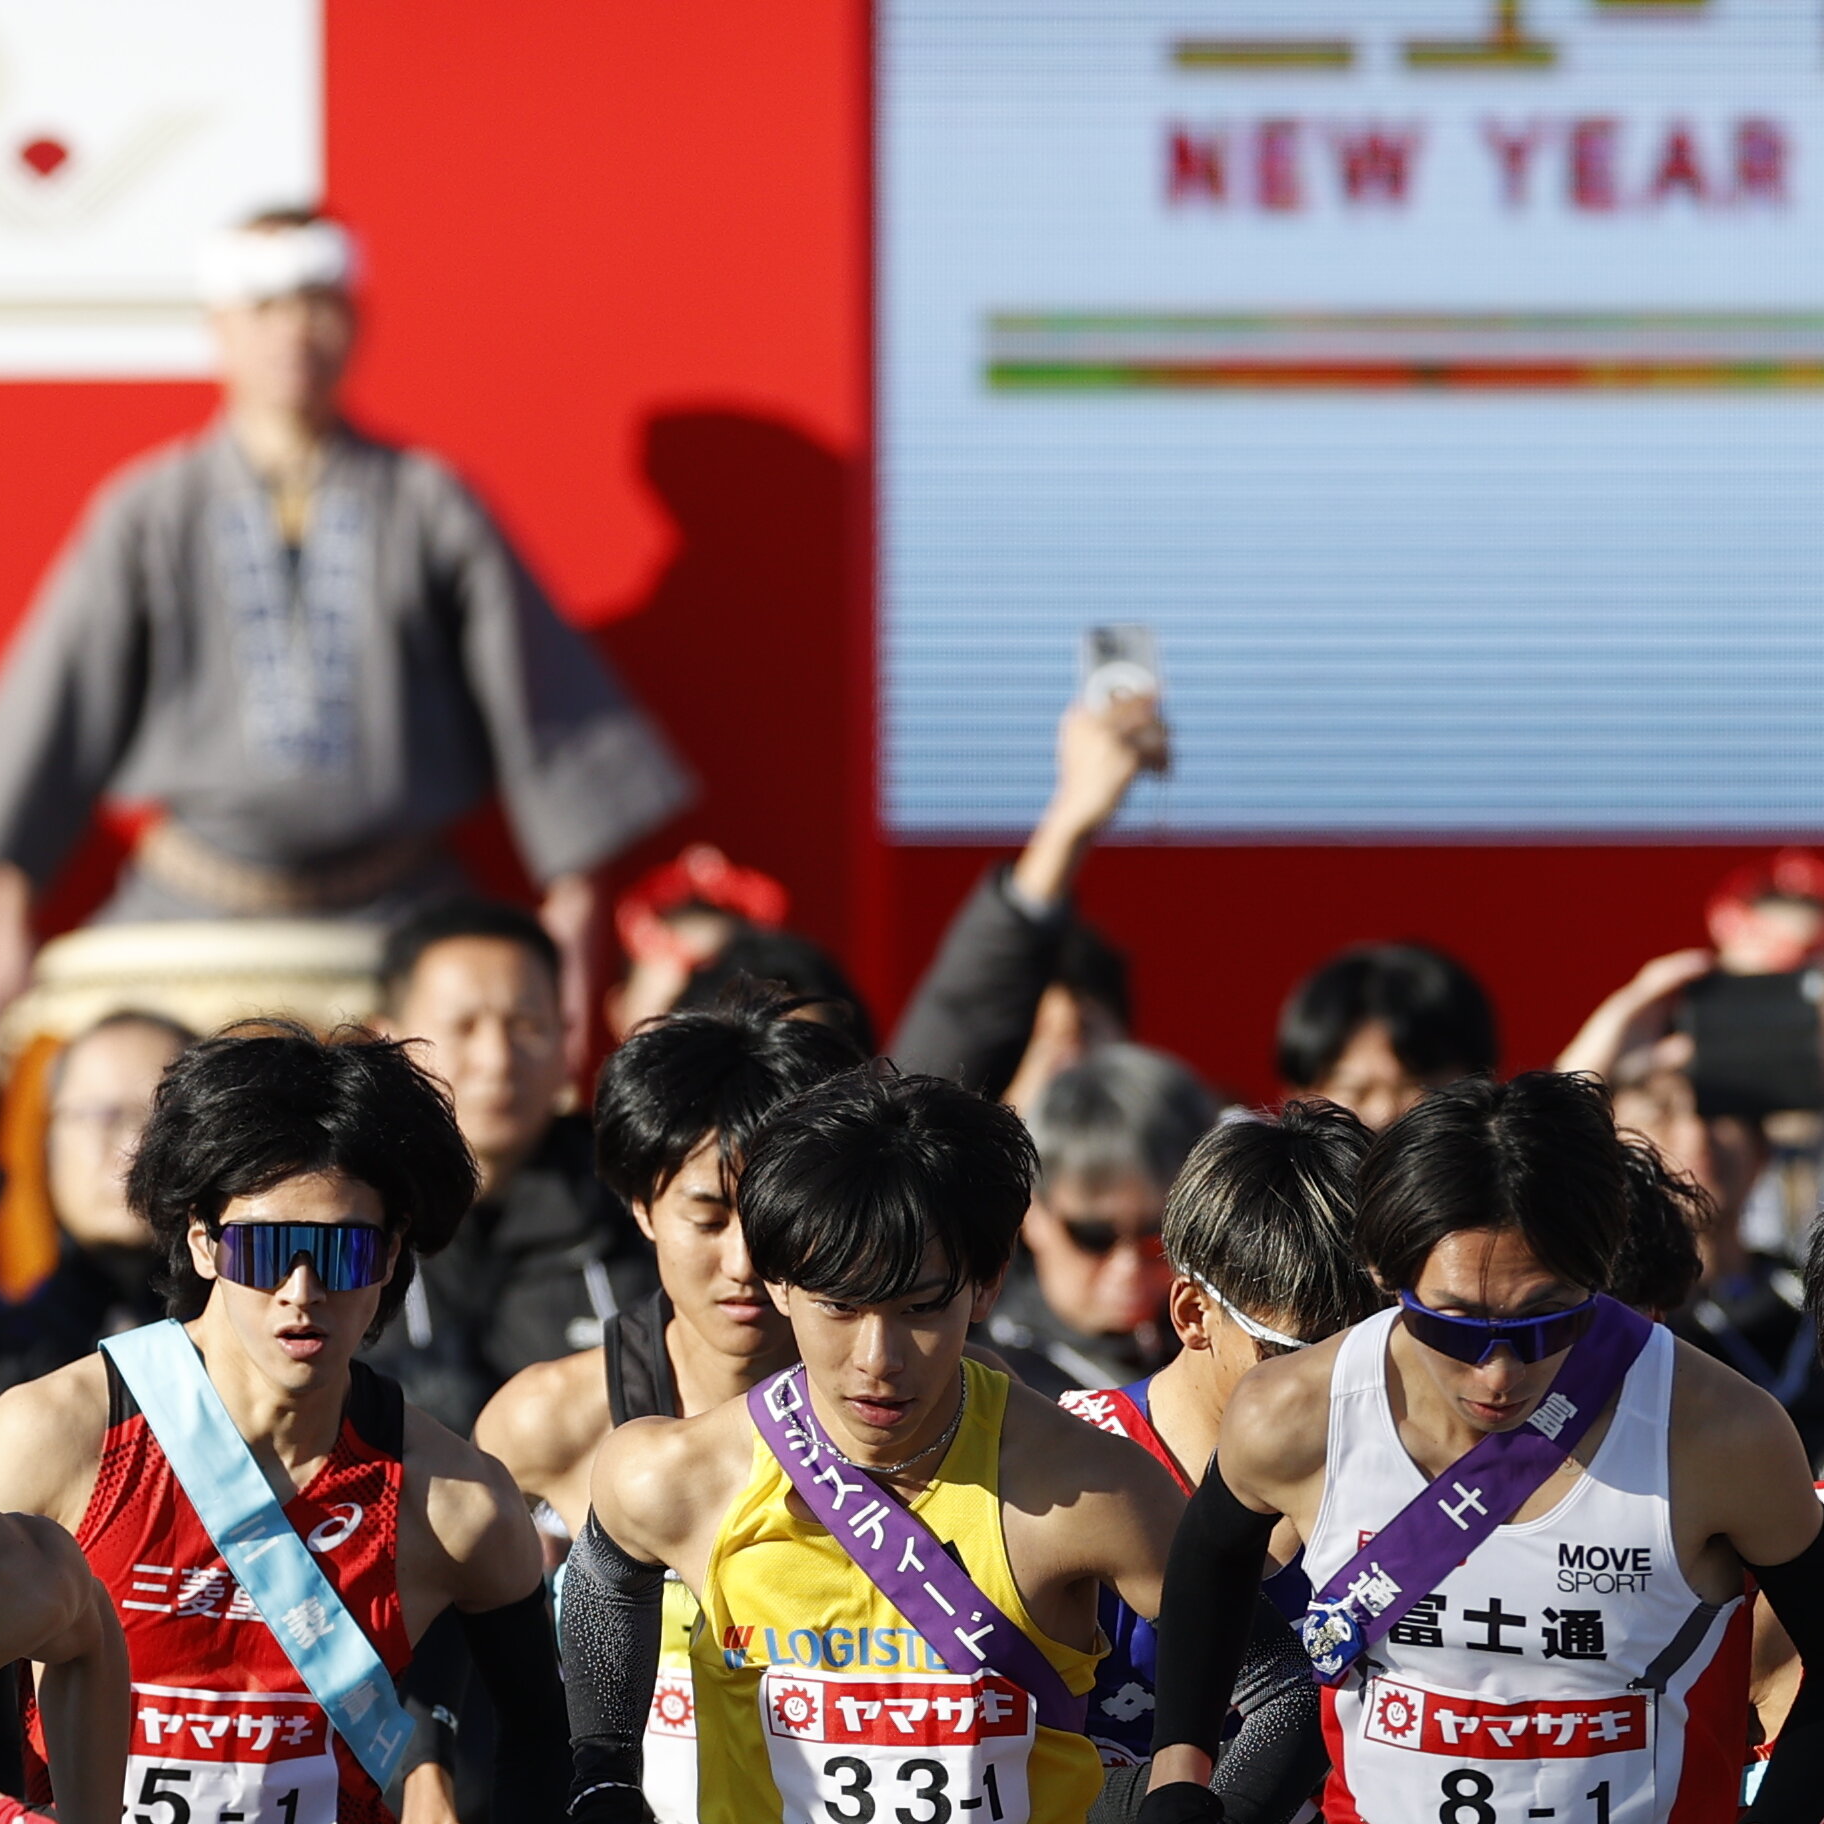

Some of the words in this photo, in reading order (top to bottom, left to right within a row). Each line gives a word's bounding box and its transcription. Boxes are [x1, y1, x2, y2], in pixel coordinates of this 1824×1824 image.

[1161, 115, 1418, 208] NEW
[1484, 115, 1788, 208] YEAR
[1348, 1391, 1578, 1618] 富士通
[1559, 1543, 1652, 1572] MOVE
[1557, 1569, 1653, 1594] SPORT
[1389, 1593, 1607, 1662] 富士通
[835, 1688, 1013, 1734] ヤマザキ
[1433, 1708, 1632, 1748] ヤマザキ
